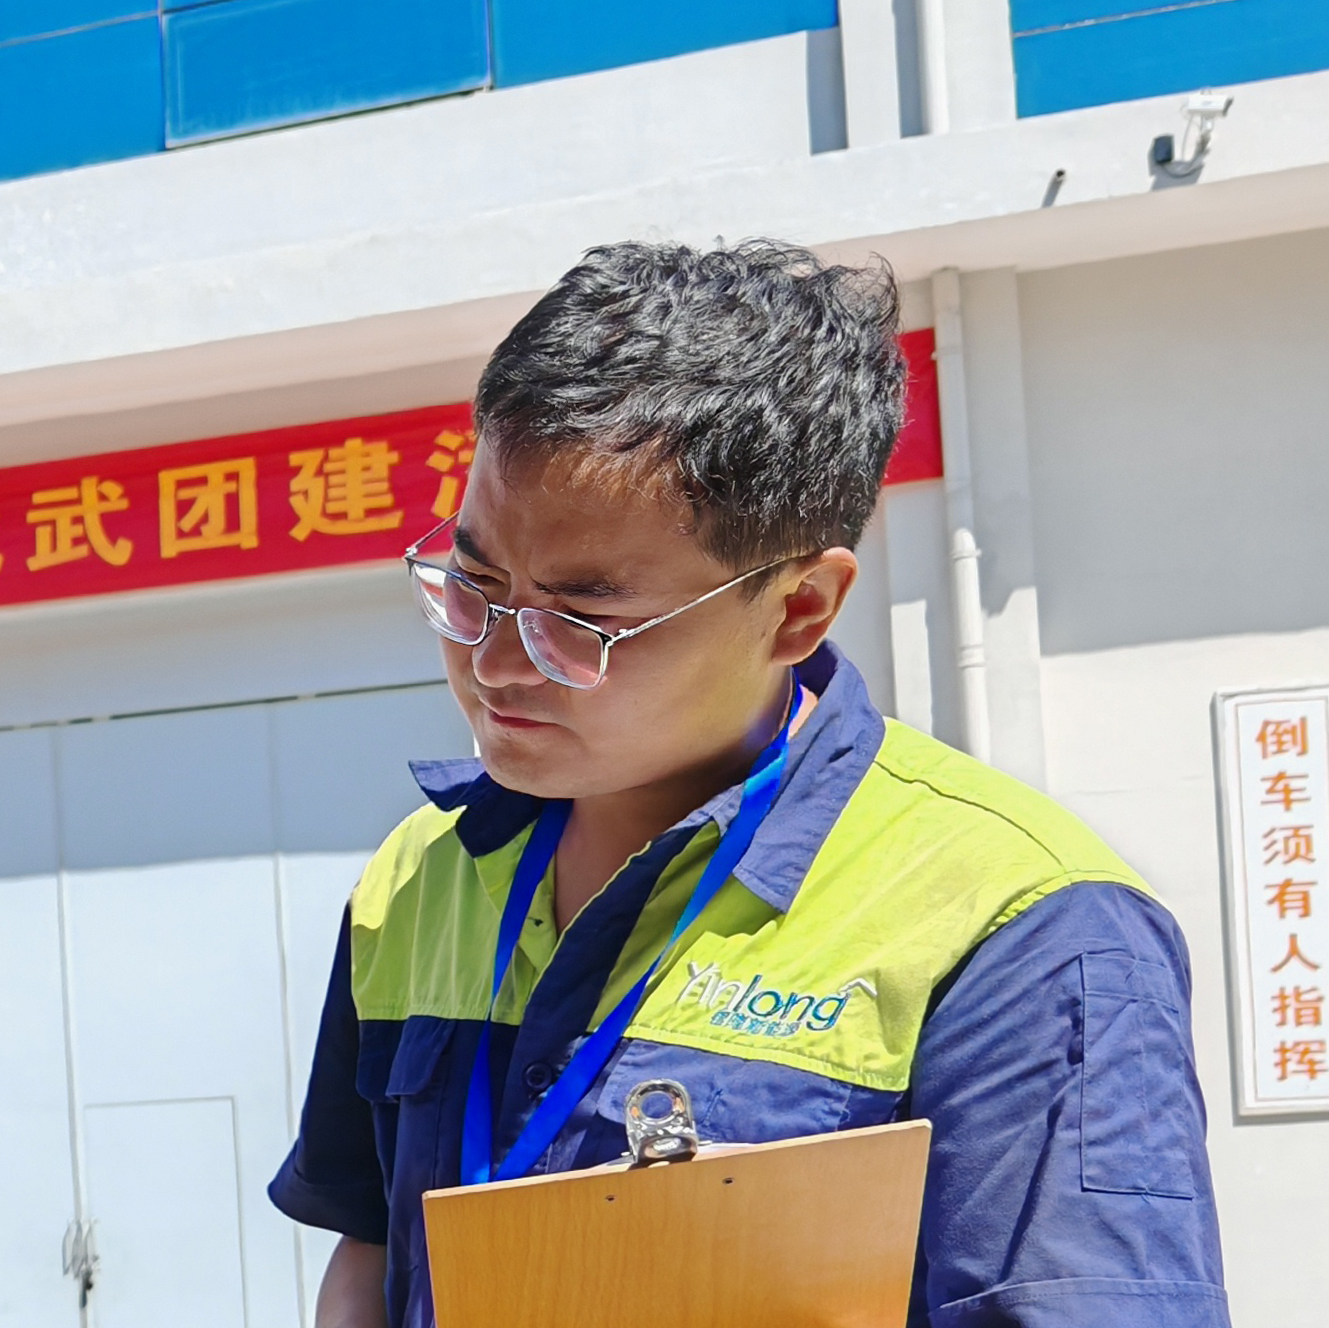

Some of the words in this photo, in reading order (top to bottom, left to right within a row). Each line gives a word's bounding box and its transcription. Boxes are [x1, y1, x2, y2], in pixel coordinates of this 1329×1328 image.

[674, 960, 851, 1031] Yinlong
[1255, 716, 1328, 1081] 倒车须有人指挥
